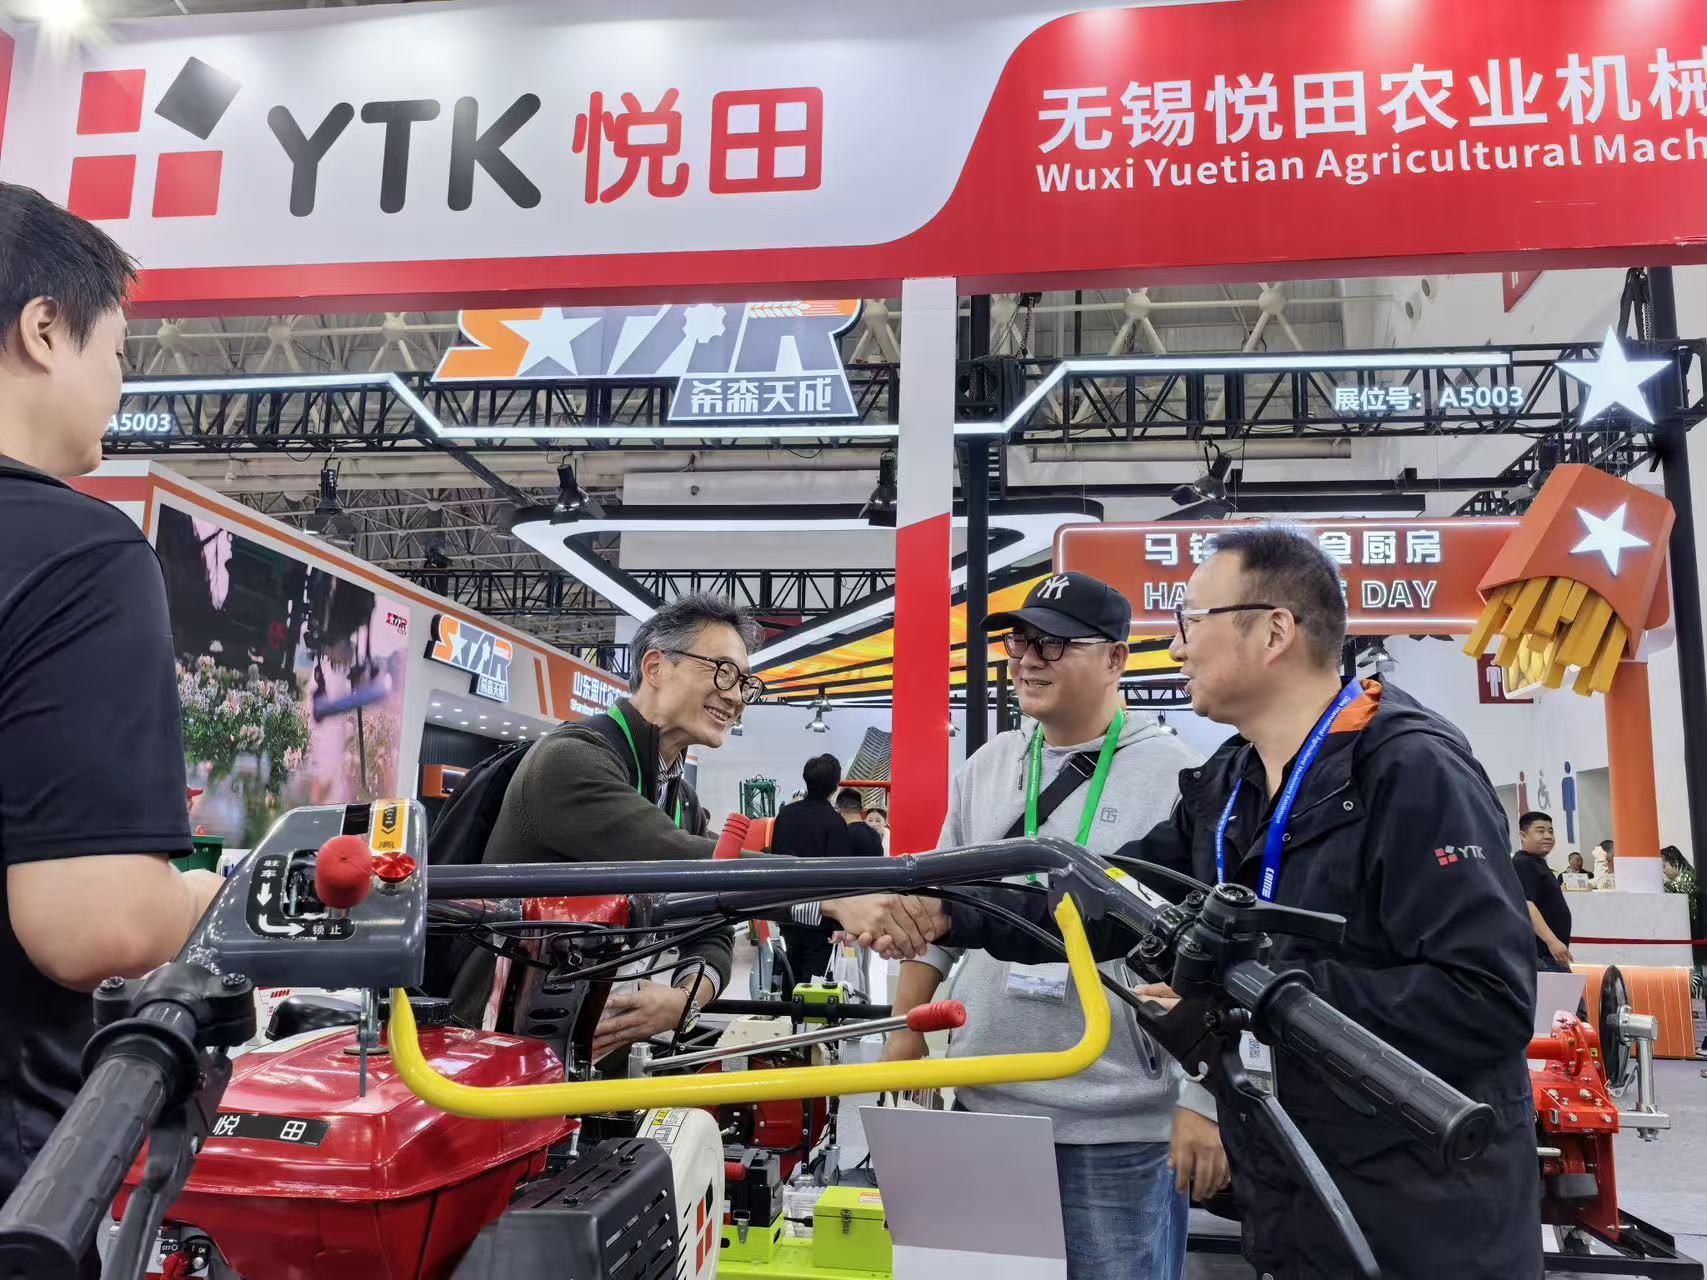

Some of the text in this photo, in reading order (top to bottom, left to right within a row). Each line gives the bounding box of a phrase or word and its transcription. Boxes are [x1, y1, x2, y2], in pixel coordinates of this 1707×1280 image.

[1038, 46, 1707, 153] 无锡悦田农业机械
[267, 87, 823, 217] YTK 悦田
[1036, 128, 1707, 192] Wuxi Yuetian Agricultural Mach
[691, 377, 832, 413] 希森天成
[1439, 386, 1524, 408] A5003
[105, 413, 172, 432] A5003
[1362, 580, 1437, 609] DAY
[1458, 845, 1486, 860] YTK
